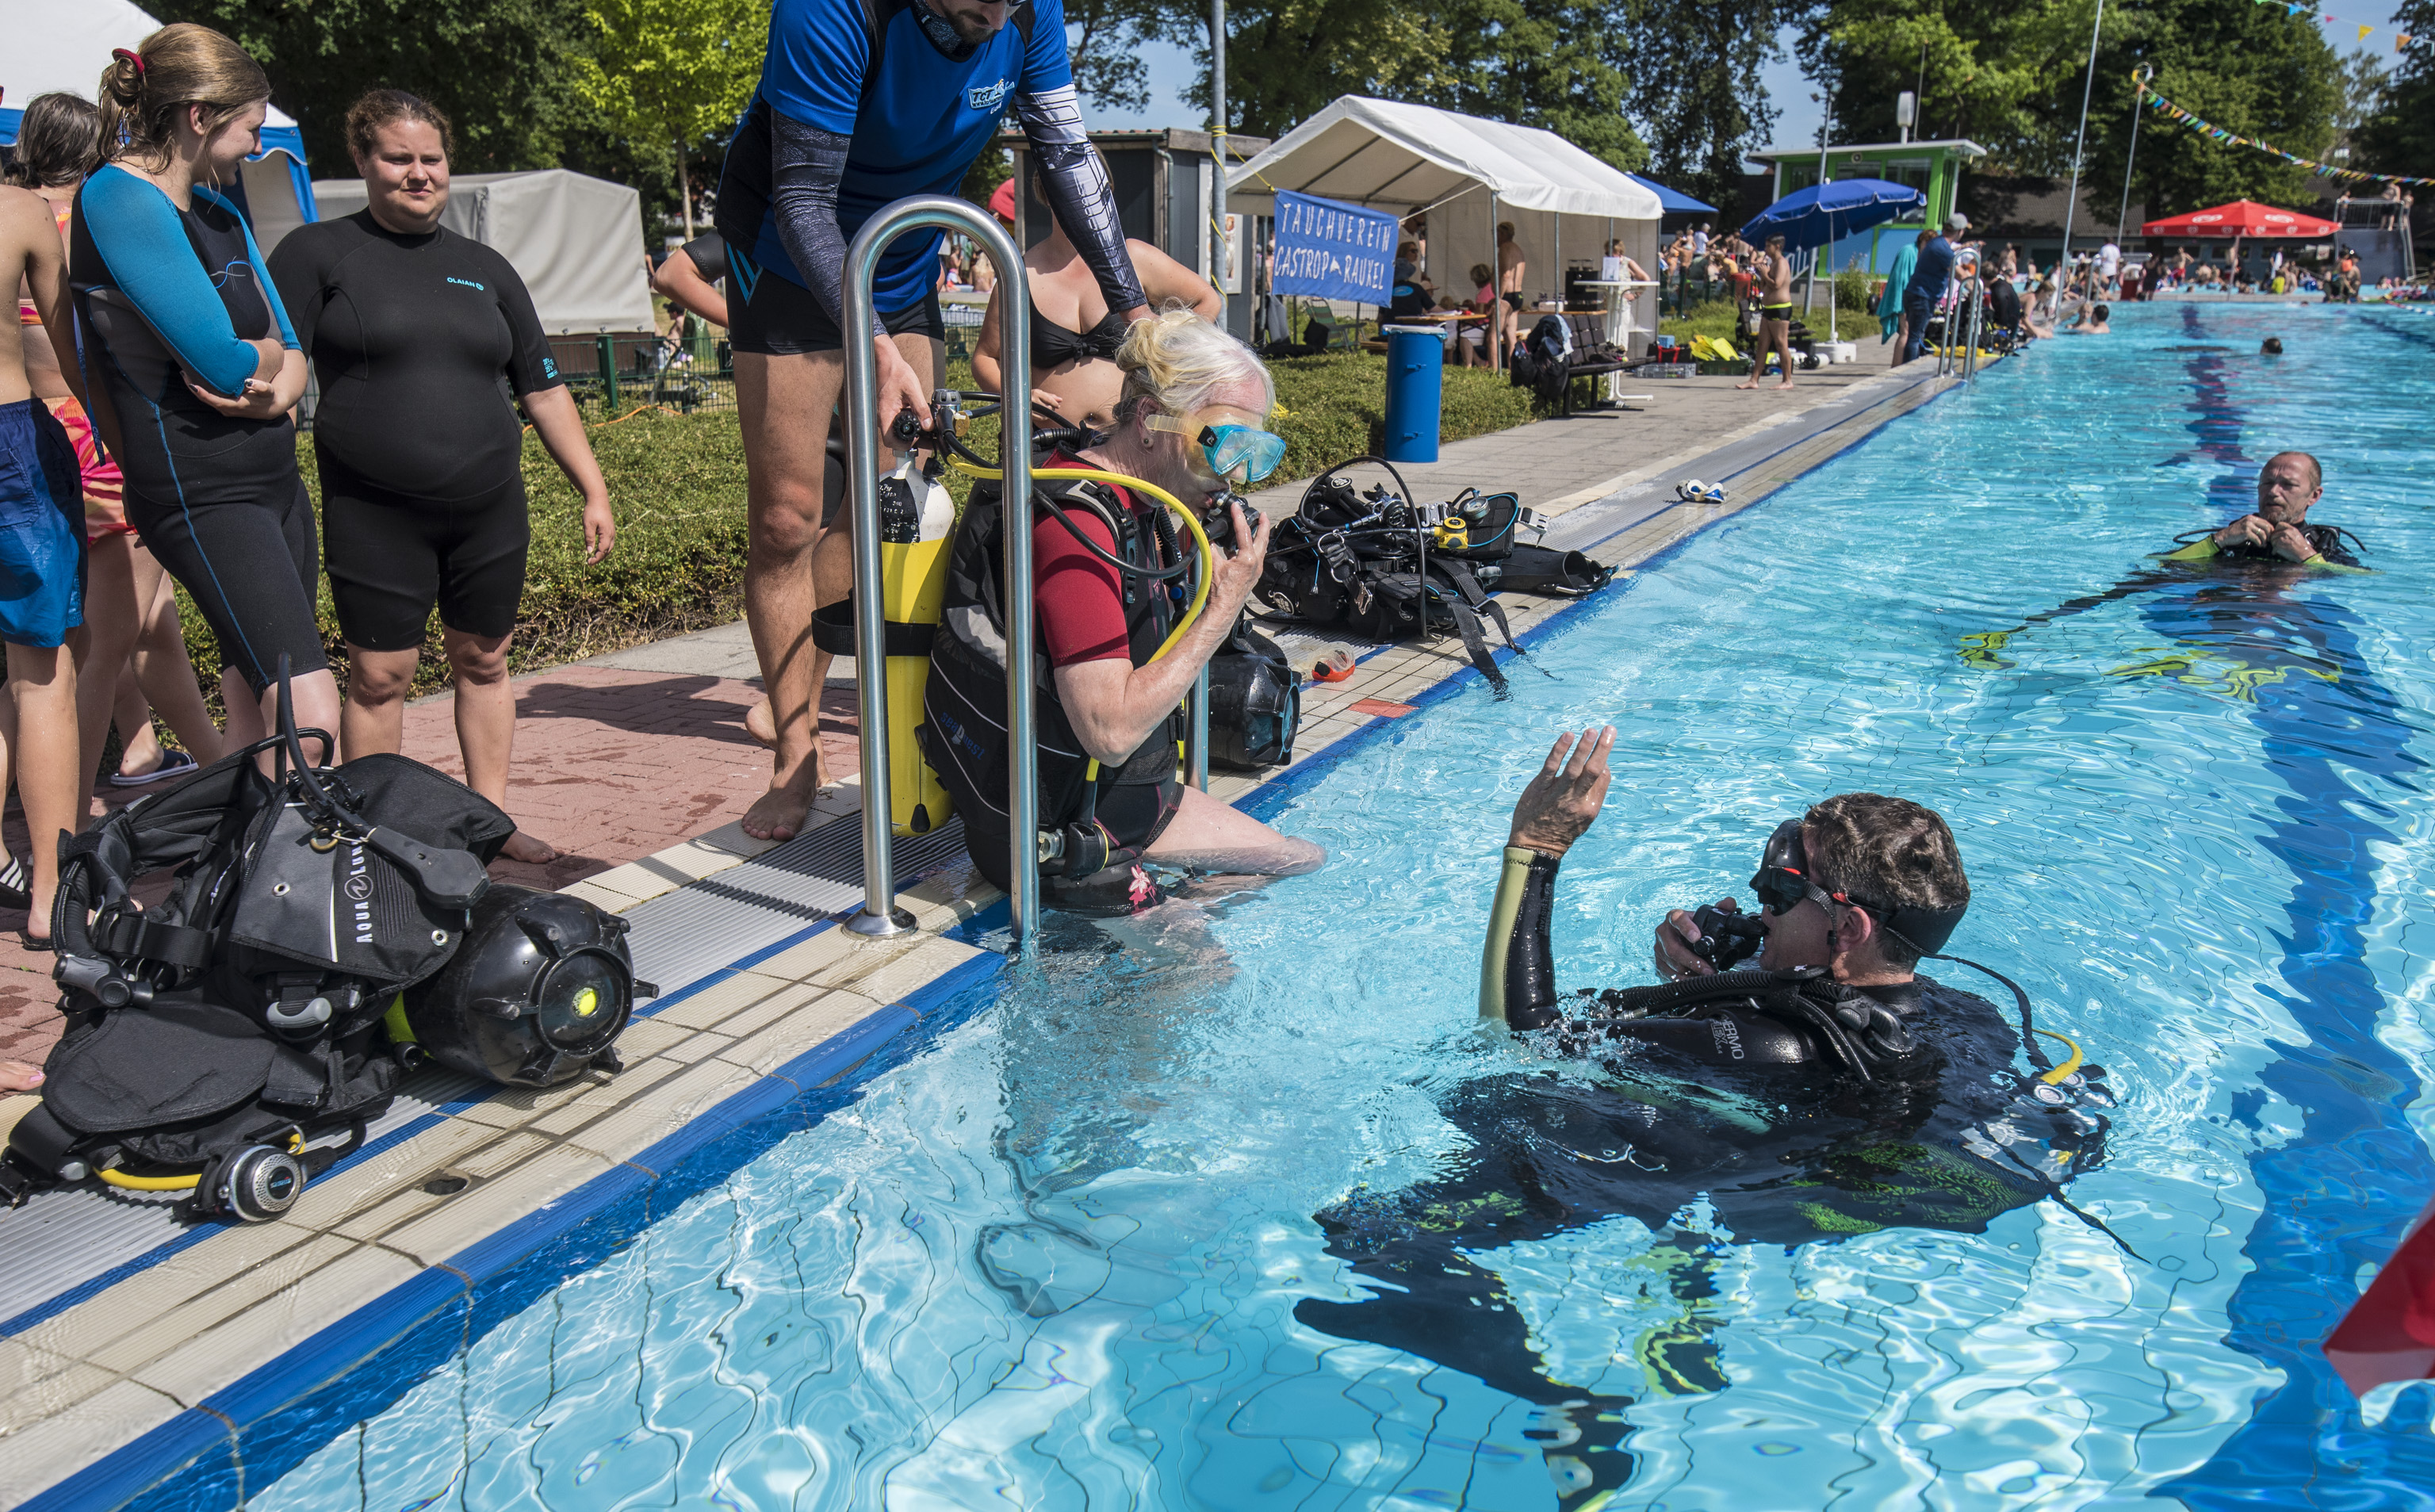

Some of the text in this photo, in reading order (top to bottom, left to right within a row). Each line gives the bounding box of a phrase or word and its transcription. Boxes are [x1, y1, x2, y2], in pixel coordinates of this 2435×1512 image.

[972, 89, 995, 102] TCT
[1281, 203, 1392, 253] TAUCHVEREIN
[446, 277, 475, 288] OLAIAN
[1274, 245, 1384, 290] CASTROP RAUXEL
[356, 901, 373, 944] AQUA
